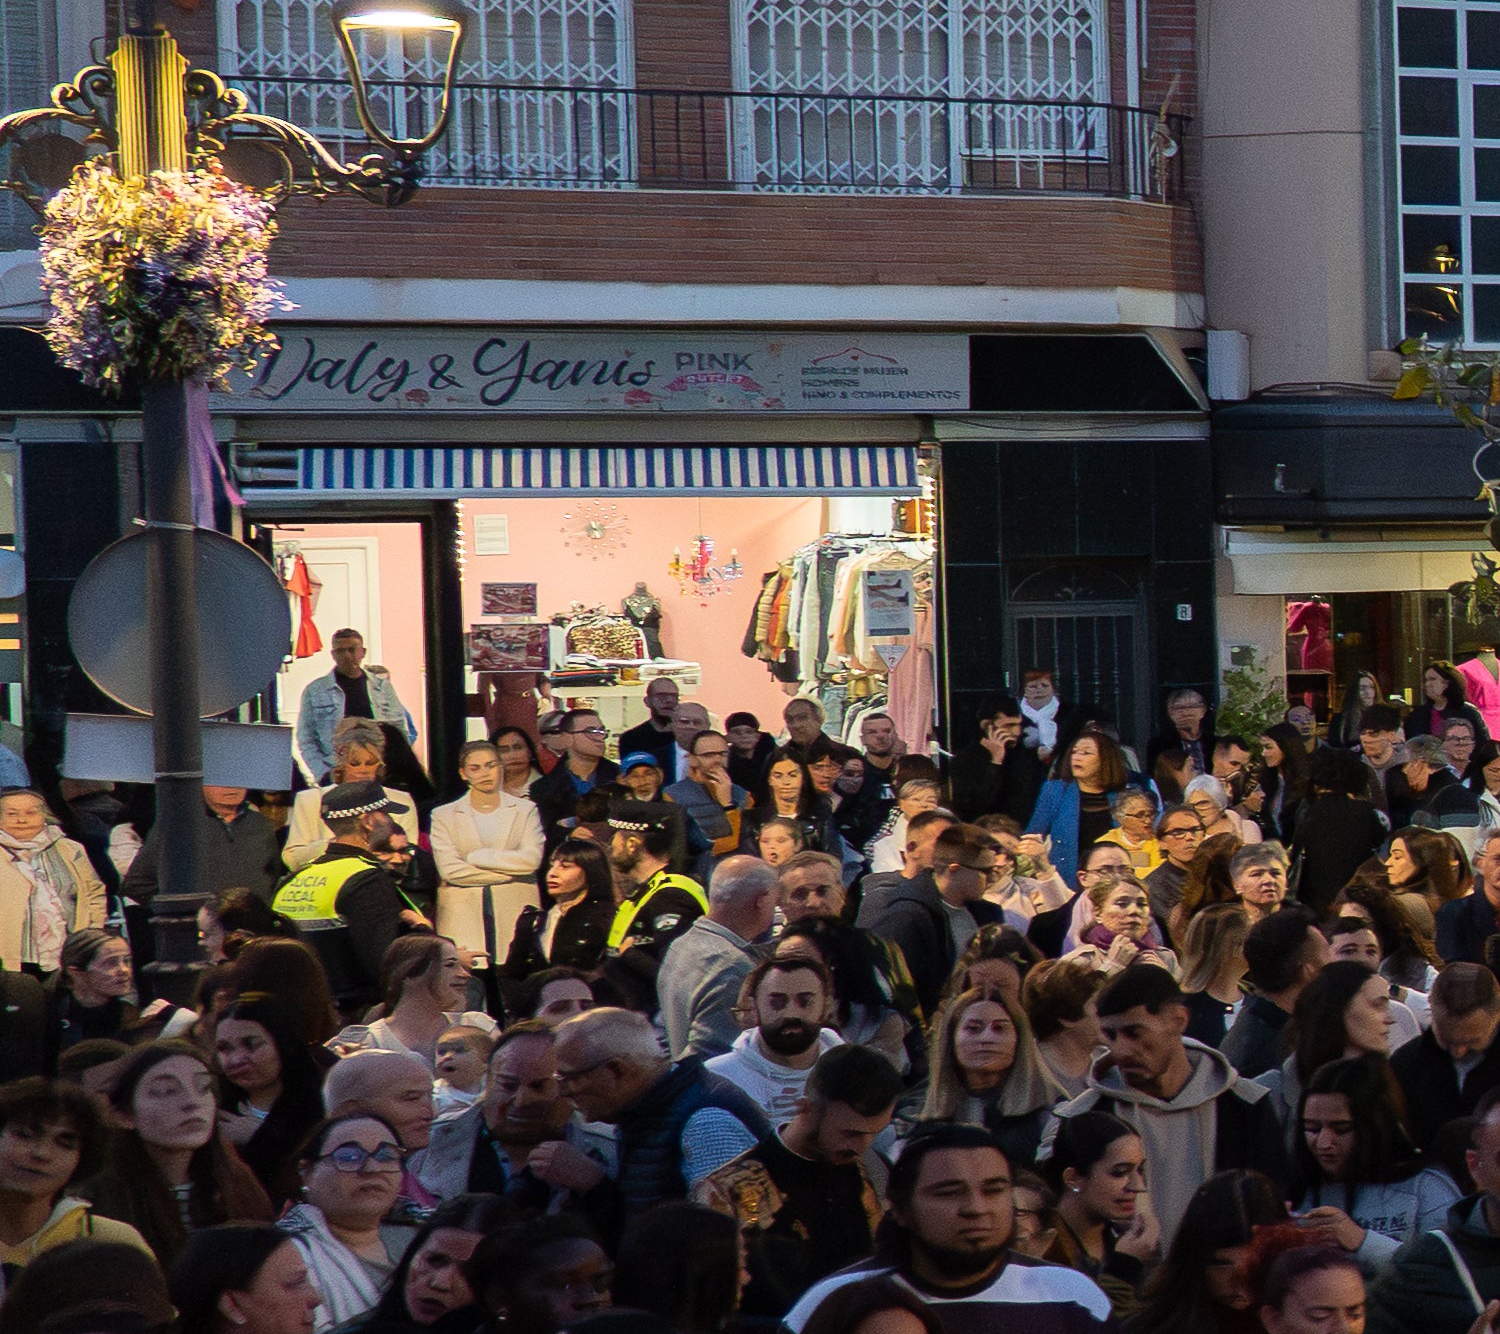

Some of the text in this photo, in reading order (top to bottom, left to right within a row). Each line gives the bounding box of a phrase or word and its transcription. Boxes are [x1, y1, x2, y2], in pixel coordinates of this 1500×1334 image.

[675, 352, 754, 371] PINK
[427, 353, 464, 390] &
[850, 390, 961, 400] COMPLEMENTOS
[289, 875, 327, 888] LICIA
[281, 890, 316, 903] LOCAL
